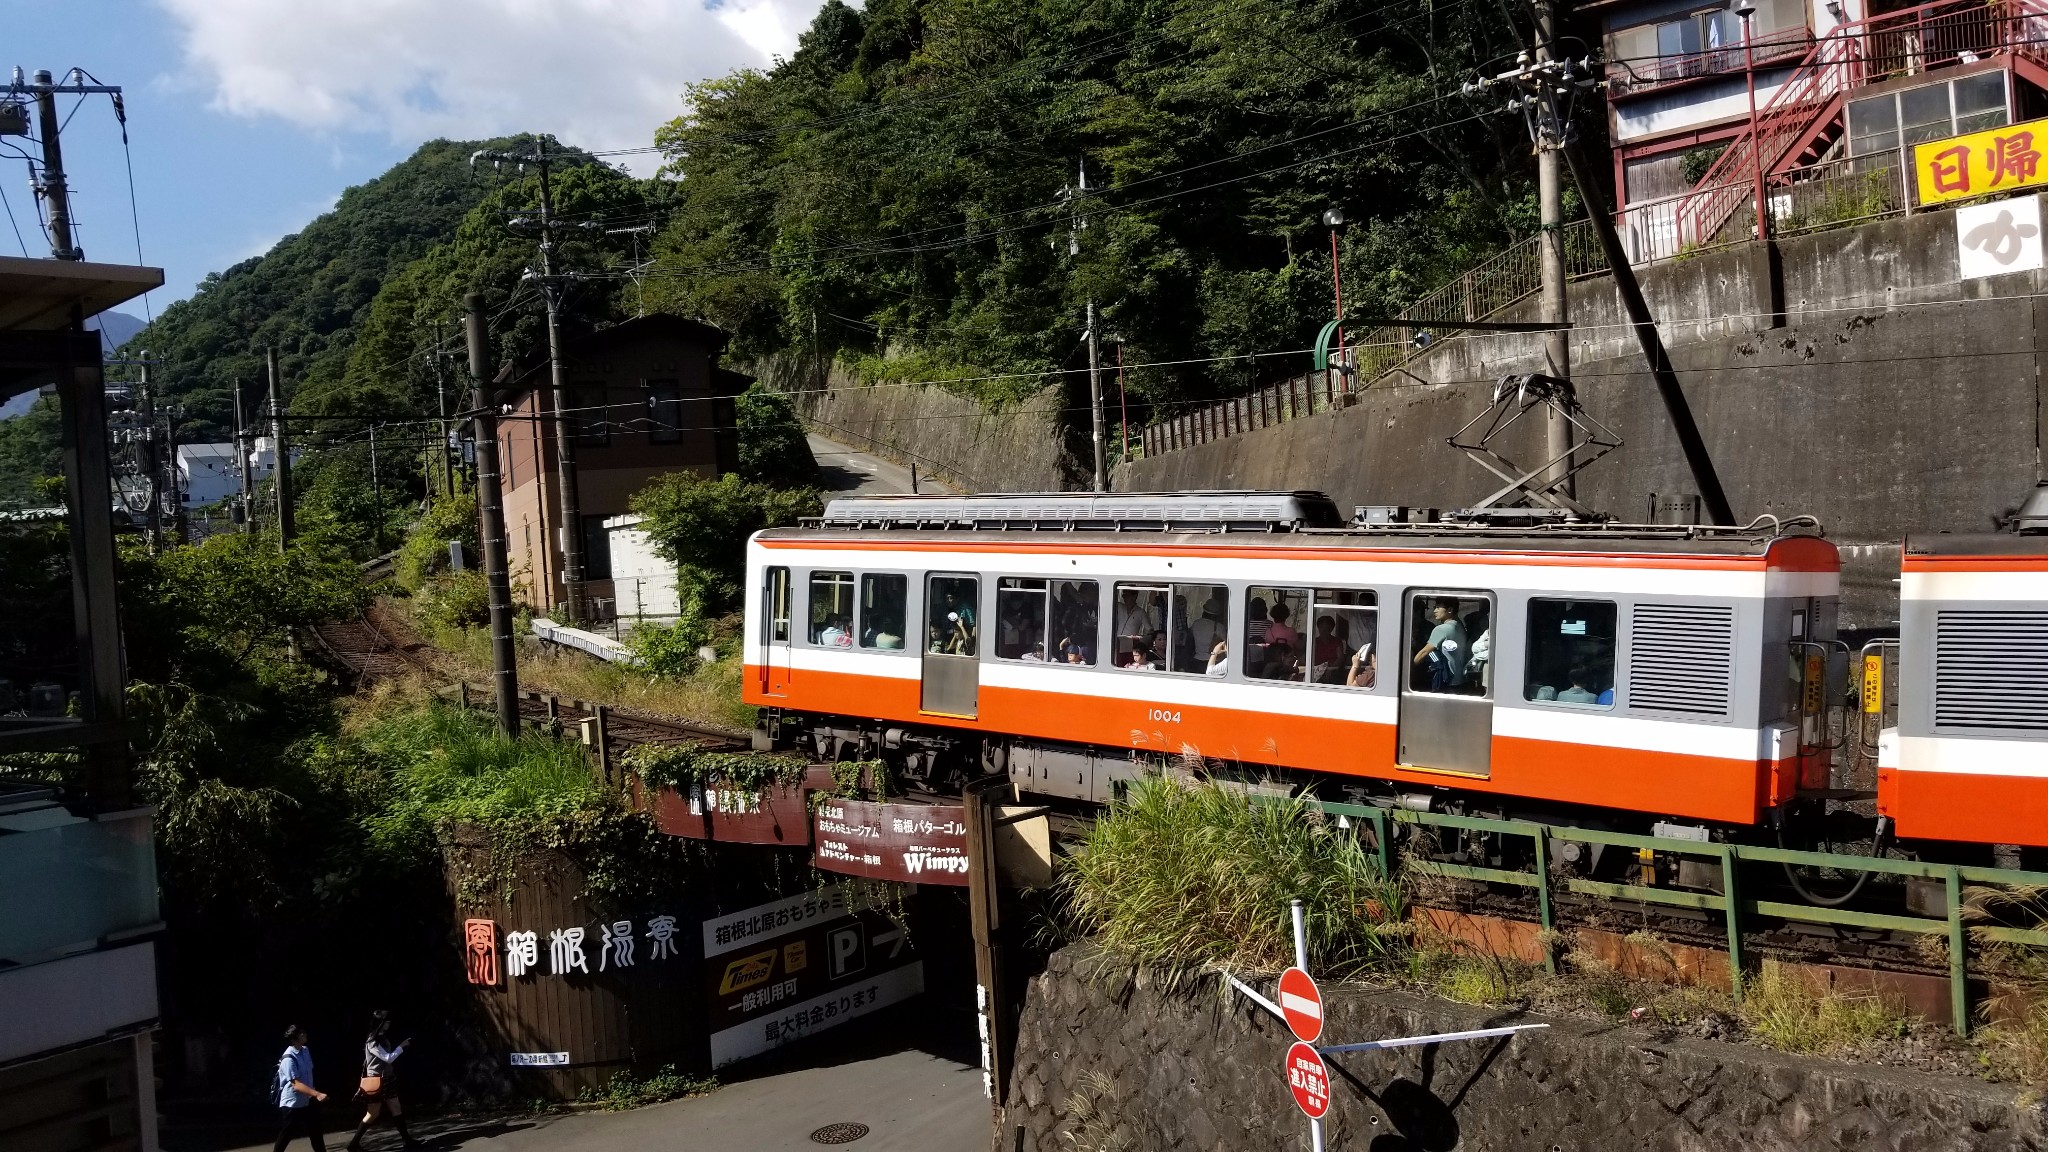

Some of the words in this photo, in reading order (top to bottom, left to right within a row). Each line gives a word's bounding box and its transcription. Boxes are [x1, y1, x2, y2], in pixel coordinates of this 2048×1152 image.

[1962, 210, 2039, 265] か
[1148, 709, 1182, 723] 1004
[819, 820, 880, 838] おもちゃミュージアム
[824, 840, 849, 851] フォレスト
[903, 853, 969, 874] Wimpy
[833, 929, 858, 975] P
[728, 962, 768, 989] Times
[727, 977, 798, 1013] 一般利用可
[765, 986, 878, 1042] 最大料金あります
[1290, 1067, 1327, 1099] 進入禁止
